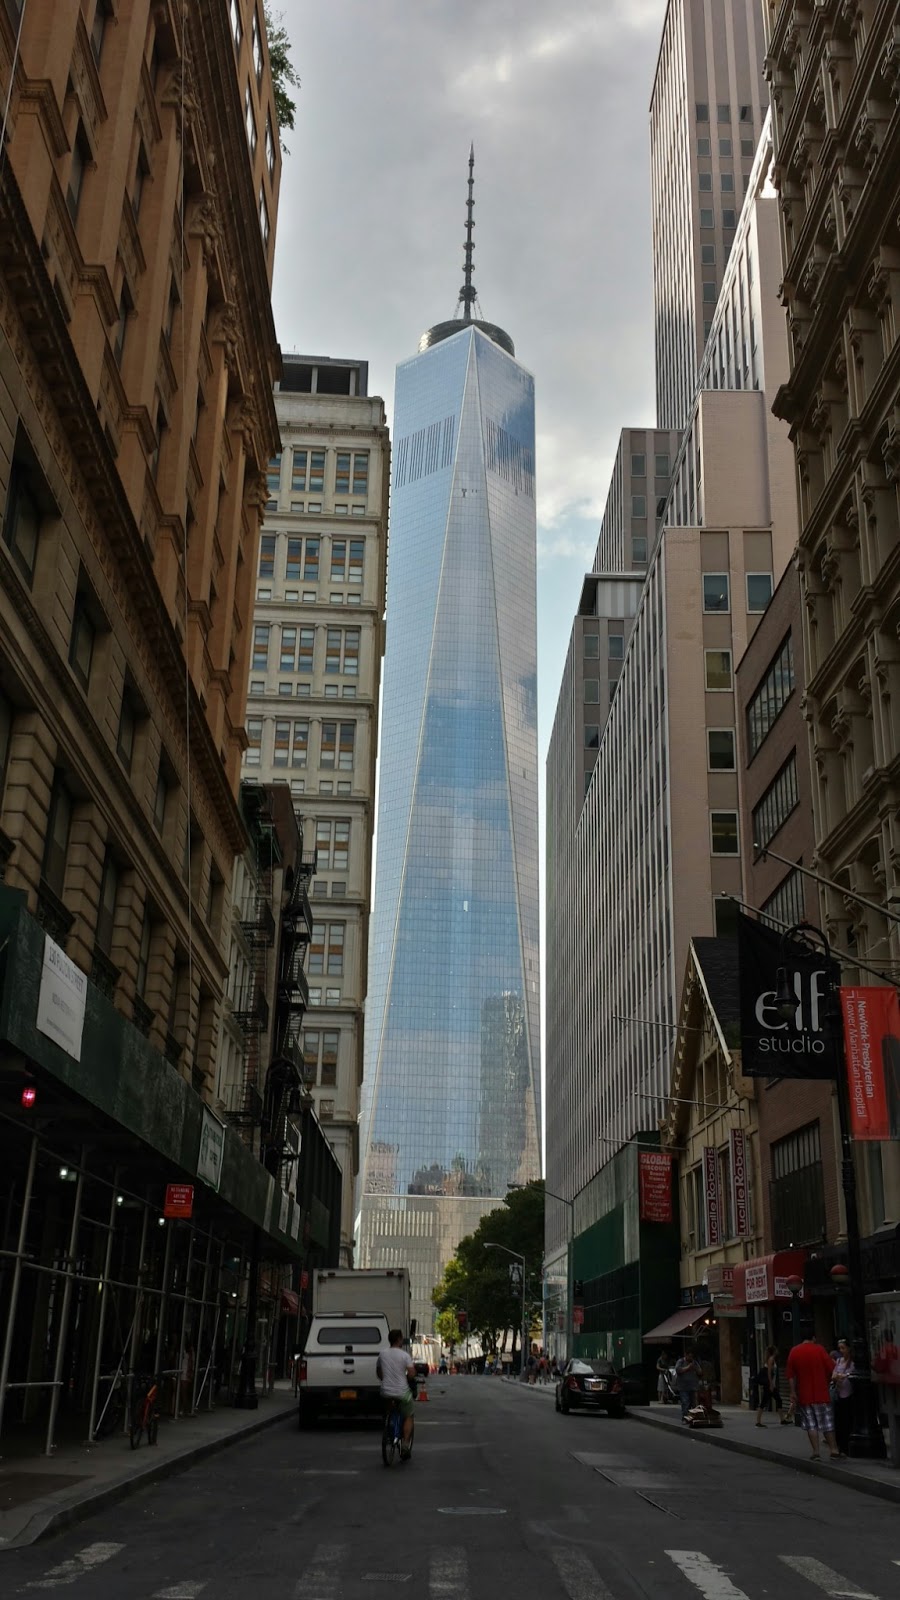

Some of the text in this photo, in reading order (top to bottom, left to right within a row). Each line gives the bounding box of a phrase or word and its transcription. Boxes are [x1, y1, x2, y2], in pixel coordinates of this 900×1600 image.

[758, 1035, 825, 1054] studio
[846, 1000, 868, 1118] Lower Manhattan Hospital
[857, 1000, 875, 1098] NewYork-Presbyterian
[640, 1154, 671, 1165] GLOBAL
[706, 1148, 718, 1245] Lucille Roberts
[734, 1130, 746, 1235] Lucille Roberts
[747, 1278, 755, 1289] FOR
[756, 1275, 766, 1287] RENT
